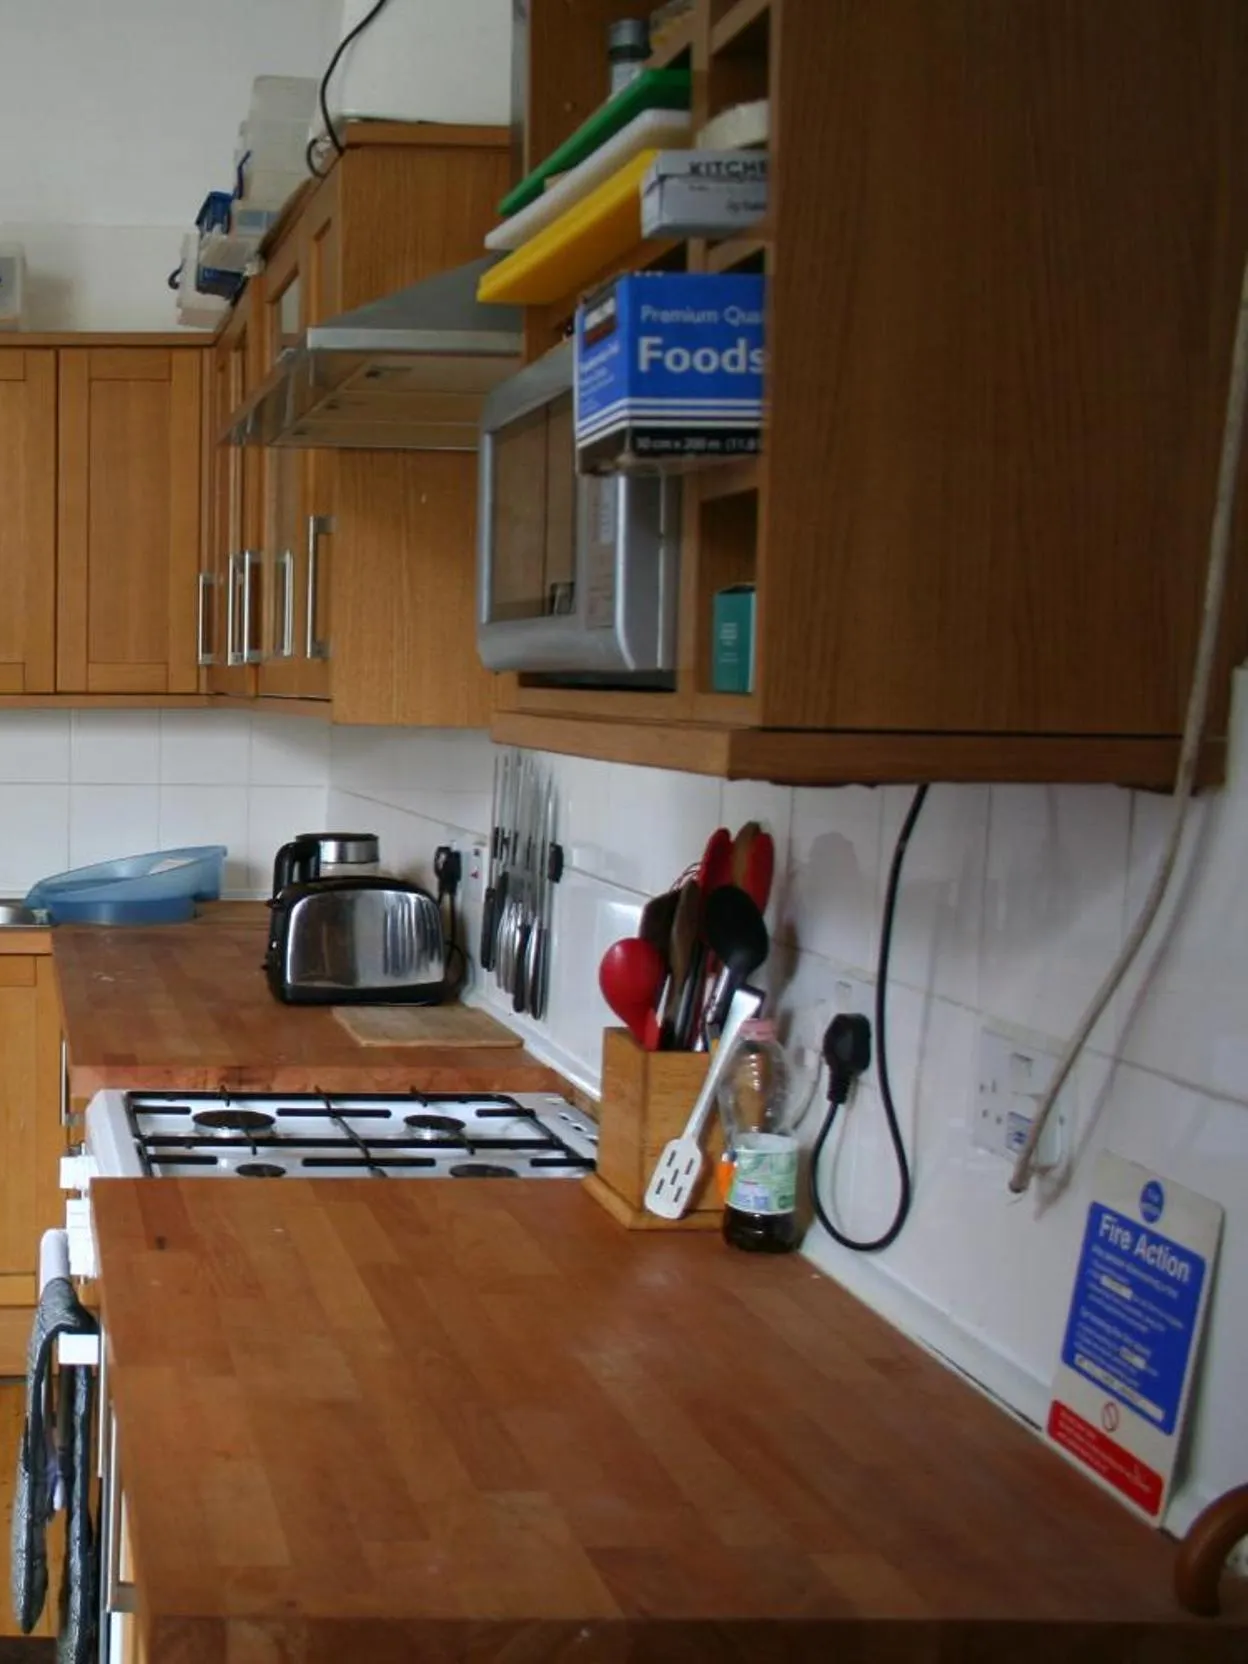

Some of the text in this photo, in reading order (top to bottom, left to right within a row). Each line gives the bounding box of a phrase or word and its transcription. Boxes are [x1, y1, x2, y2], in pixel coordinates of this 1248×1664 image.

[641, 305, 719, 325] Premium
[638, 336, 768, 374] Foods
[1098, 1213, 1131, 1251] Fire
[1133, 1233, 1190, 1284] Action
